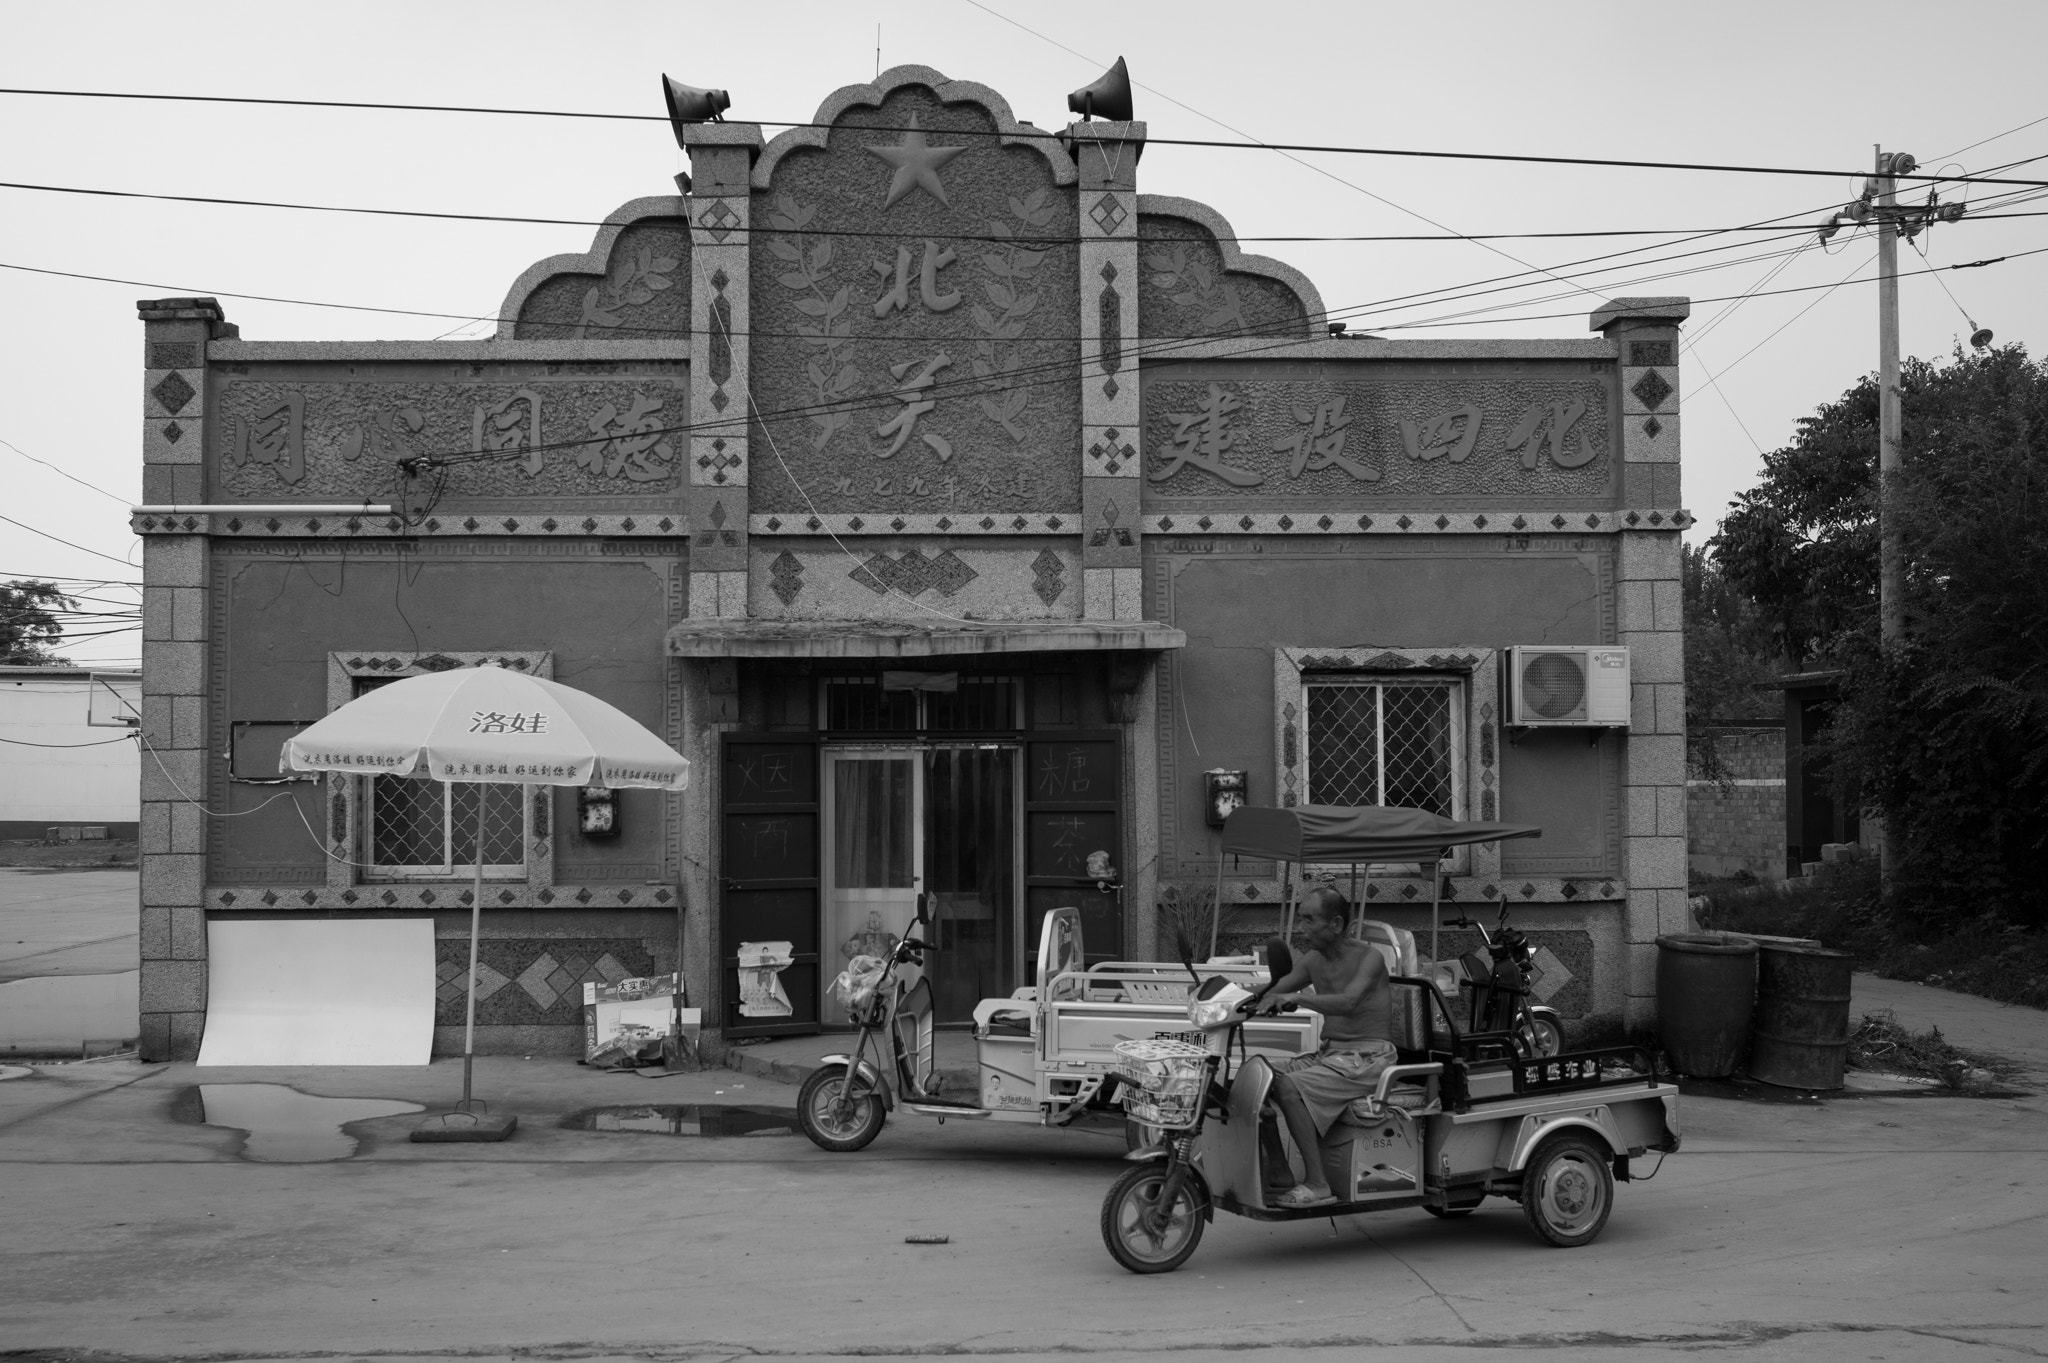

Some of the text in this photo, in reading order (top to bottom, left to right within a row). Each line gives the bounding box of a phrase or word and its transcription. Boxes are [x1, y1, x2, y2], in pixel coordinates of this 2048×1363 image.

[232, 387, 674, 485] 同心同德
[1148, 383, 1598, 487] 建设四化
[467, 710, 548, 735] 洛娃
[444, 763, 508, 776] 洗衣用洛娃
[514, 764, 577, 779] 好运到你家
[737, 752, 794, 798] 烟
[1040, 746, 1091, 796] 糖
[1047, 815, 1088, 872] 茶
[1373, 1139, 1393, 1149] BSA
